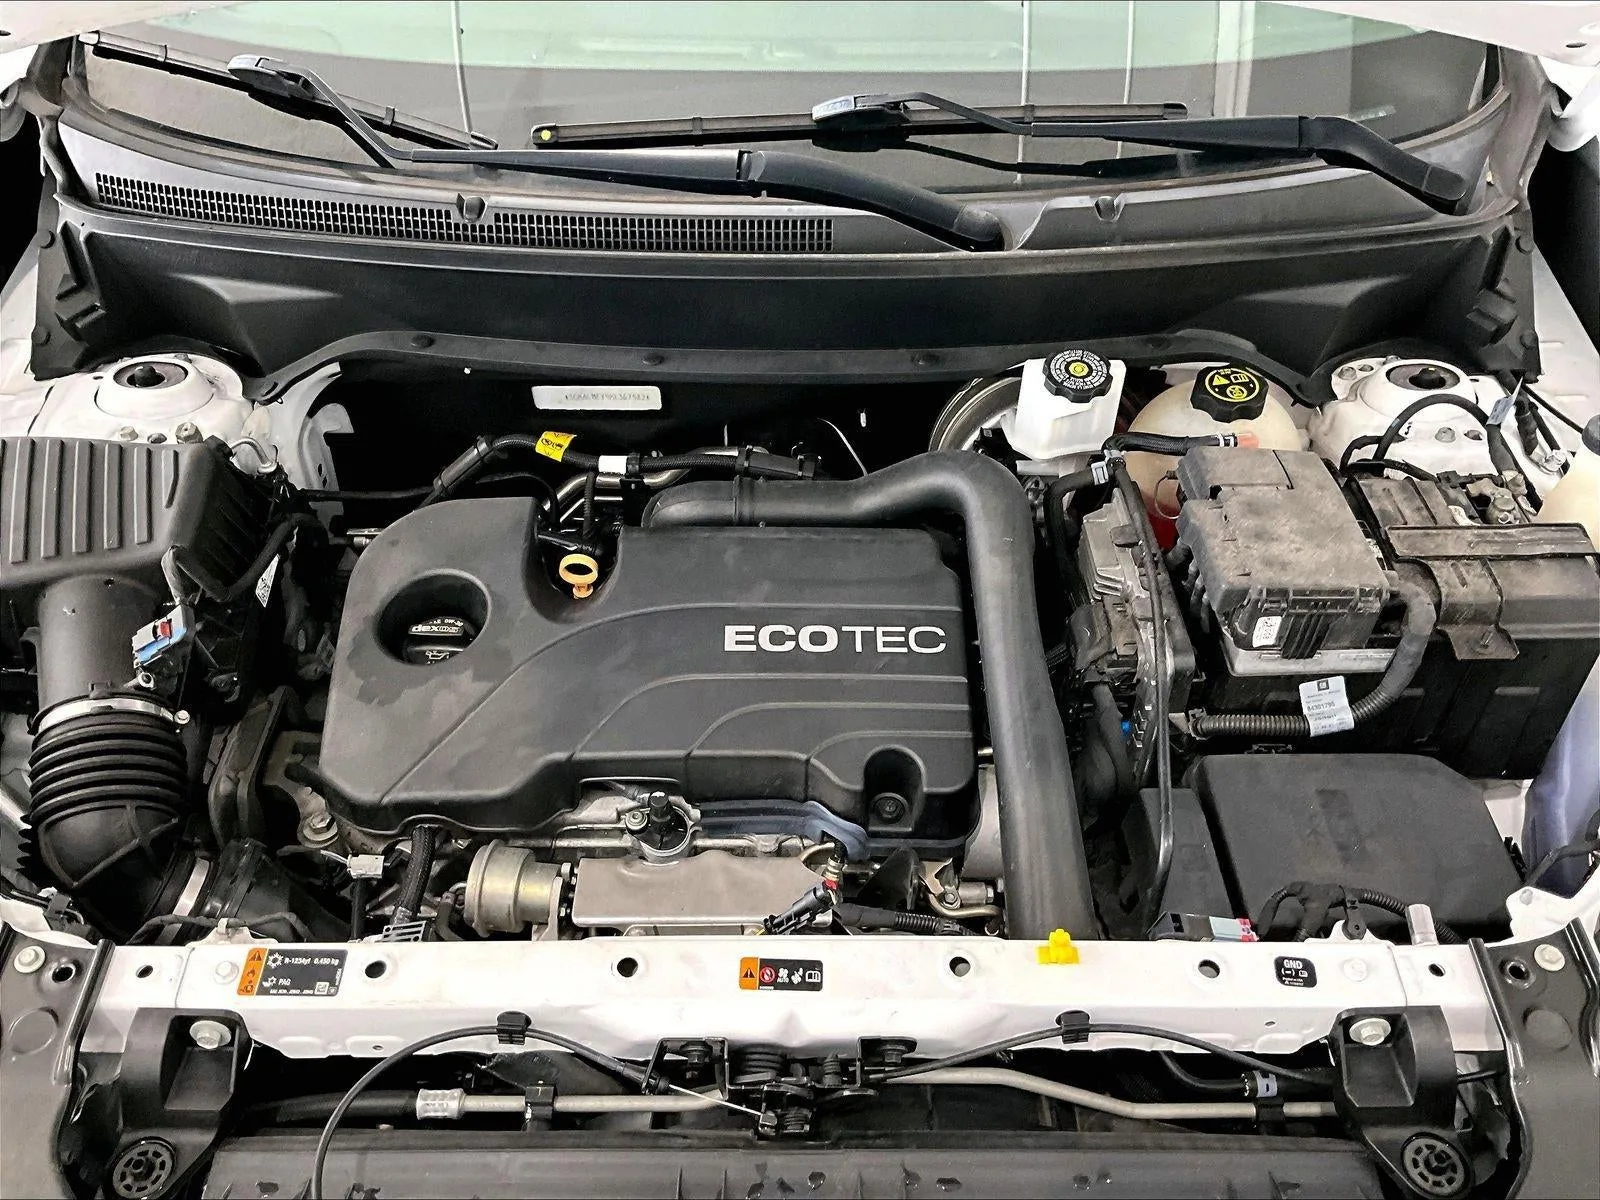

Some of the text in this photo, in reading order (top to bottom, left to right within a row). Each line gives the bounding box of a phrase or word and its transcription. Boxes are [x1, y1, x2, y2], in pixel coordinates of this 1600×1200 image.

[411, 624, 460, 634] dexos
[724, 624, 947, 654] ECOTEC
[331, 958, 340, 967] kg
[1283, 958, 1304, 970] GND
